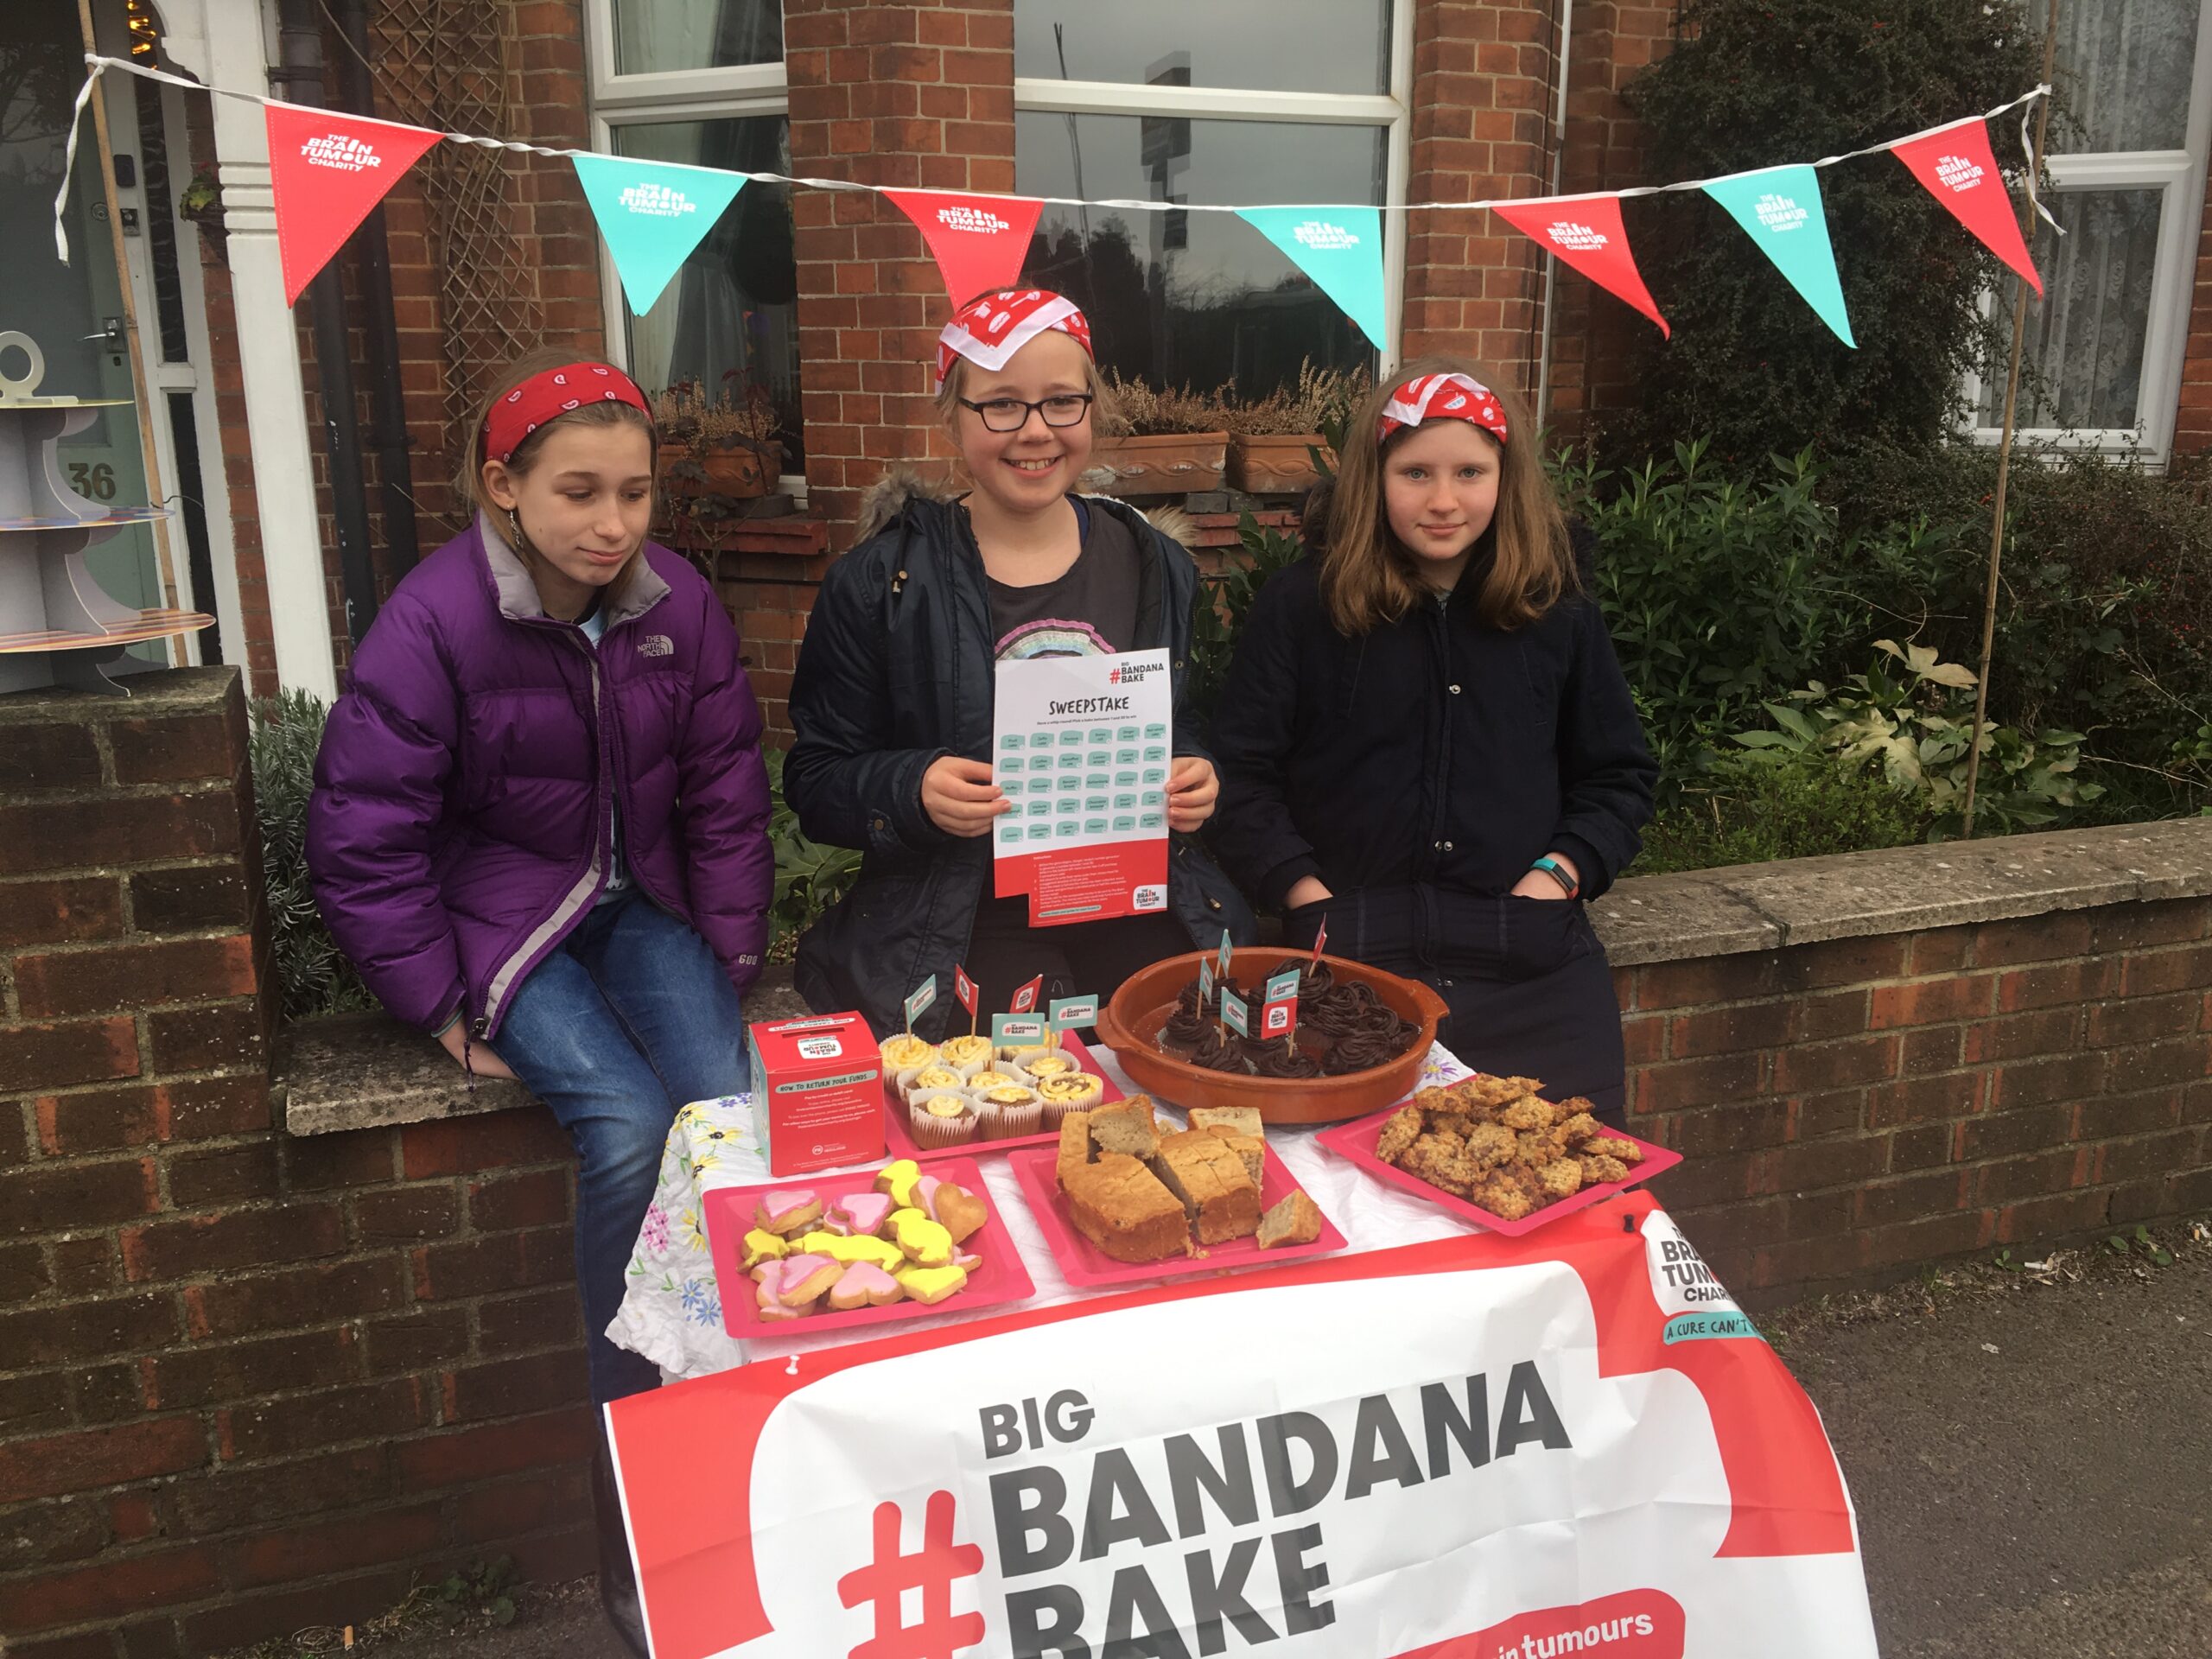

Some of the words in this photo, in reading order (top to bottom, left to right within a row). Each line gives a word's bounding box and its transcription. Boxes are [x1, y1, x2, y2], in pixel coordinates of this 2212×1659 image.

[307, 137, 373, 156] BRAIN
[300, 145, 381, 168] TUMOUR
[308, 157, 364, 172] CHARITY
[1938, 156, 1952, 164] THE
[1936, 156, 1972, 176] BRAIN
[1939, 165, 1985, 187] TUMOUR
[623, 187, 685, 201] BRAIN
[1953, 178, 1980, 193] CHARITY
[618, 195, 696, 213] TUMOUR
[629, 207, 681, 217] CHARITY
[1755, 194, 1796, 215] BRAIN
[937, 215, 1009, 230] TUMOUR
[938, 209, 996, 221] BRAIN
[1758, 208, 1809, 226] TUMOUR
[950, 224, 998, 234] CHARITY
[1547, 223, 1593, 236] BRAIN
[1550, 234, 1609, 245] TUMOUR
[68, 462, 116, 499] 36
[638, 643, 661, 652] NORTH
[1122, 674, 1144, 683] BAKE
[1049, 696, 1129, 715] SWEEPSTAKE
[1137, 889, 1156, 898] BRAIN
[806, 1080, 830, 1089] RETURN
[849, 1073, 868, 1084] FUNDS
[1662, 1263, 1717, 1287] TUM
[1667, 1327, 1674, 1339] A
[1677, 1322, 1706, 1336] CURE
[1711, 1319, 1747, 1333] CAN'T
[979, 1389, 1096, 1459] BIG
[988, 1359, 1573, 1579] BANDANA
[1004, 1522, 1336, 1659] BAKE
